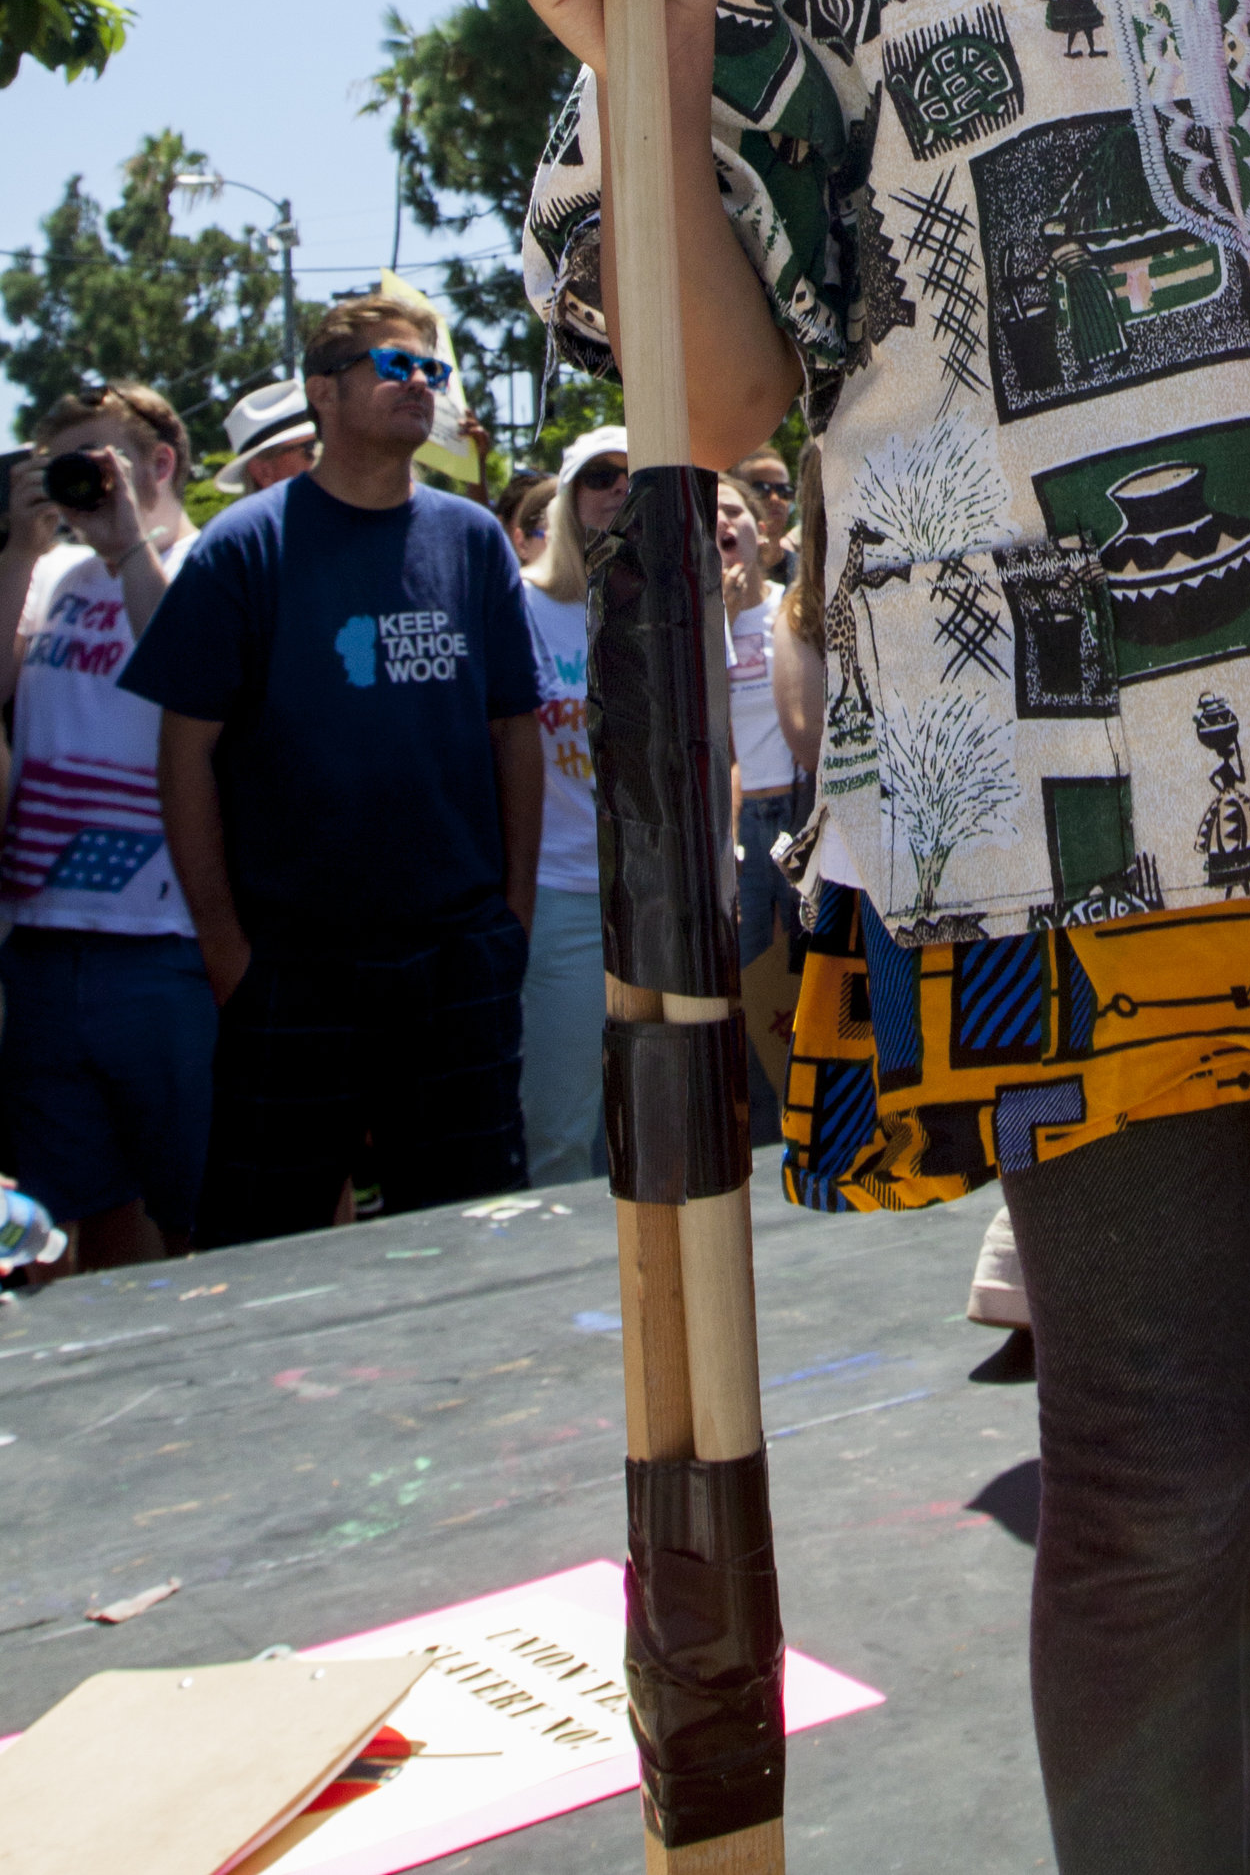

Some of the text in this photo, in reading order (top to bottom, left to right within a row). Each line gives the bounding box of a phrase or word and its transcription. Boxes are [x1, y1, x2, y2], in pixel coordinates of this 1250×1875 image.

[379, 611, 449, 636] KEEP
[382, 633, 468, 659] TAHOE
[385, 656, 456, 683] WOO!
[485, 1627, 598, 1682] UNION
[407, 1644, 613, 1750] SLAVERY NO!
